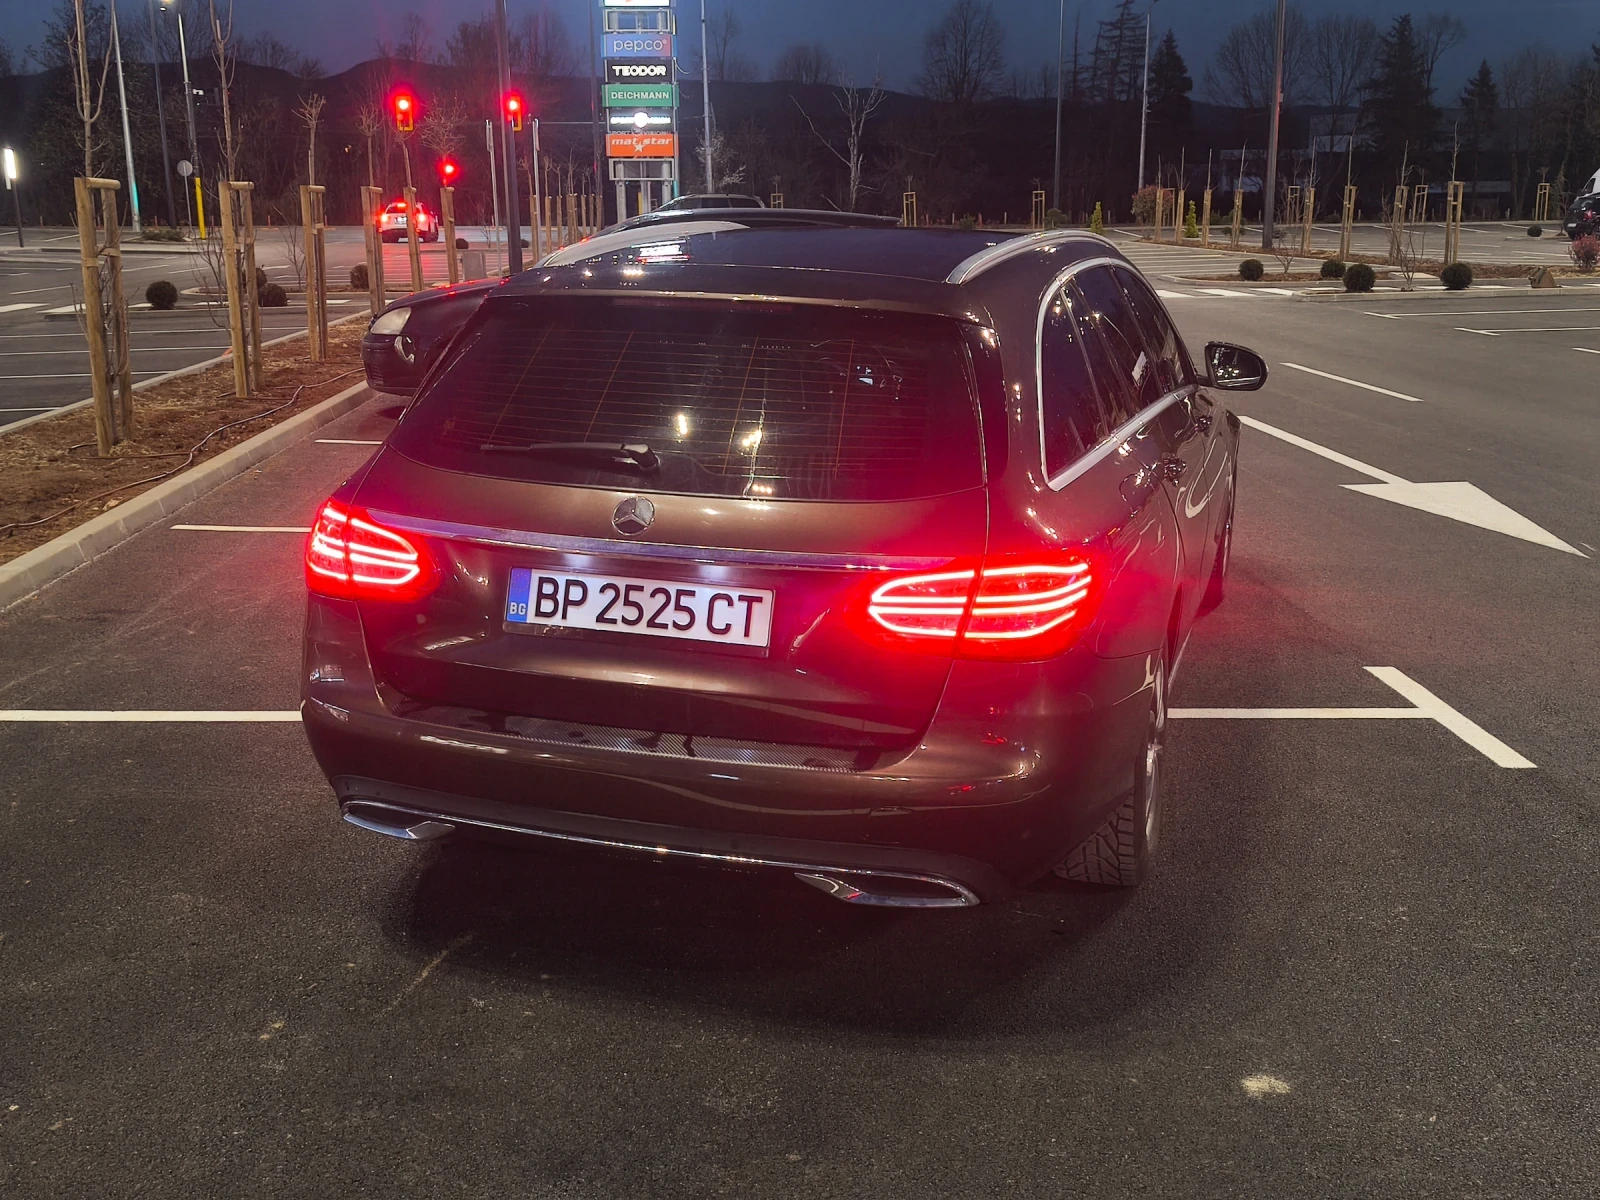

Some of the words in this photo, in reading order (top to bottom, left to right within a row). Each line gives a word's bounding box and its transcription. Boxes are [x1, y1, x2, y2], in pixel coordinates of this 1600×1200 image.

[613, 39, 664, 53] pepco
[612, 65, 667, 76] TEODOR
[611, 91, 670, 99] DEICHMANN
[611, 137, 639, 145] mat
[642, 137, 672, 145] star
[509, 601, 527, 615] BG
[535, 576, 588, 620] BP
[595, 582, 697, 631] 2525
[706, 592, 764, 638] CT
